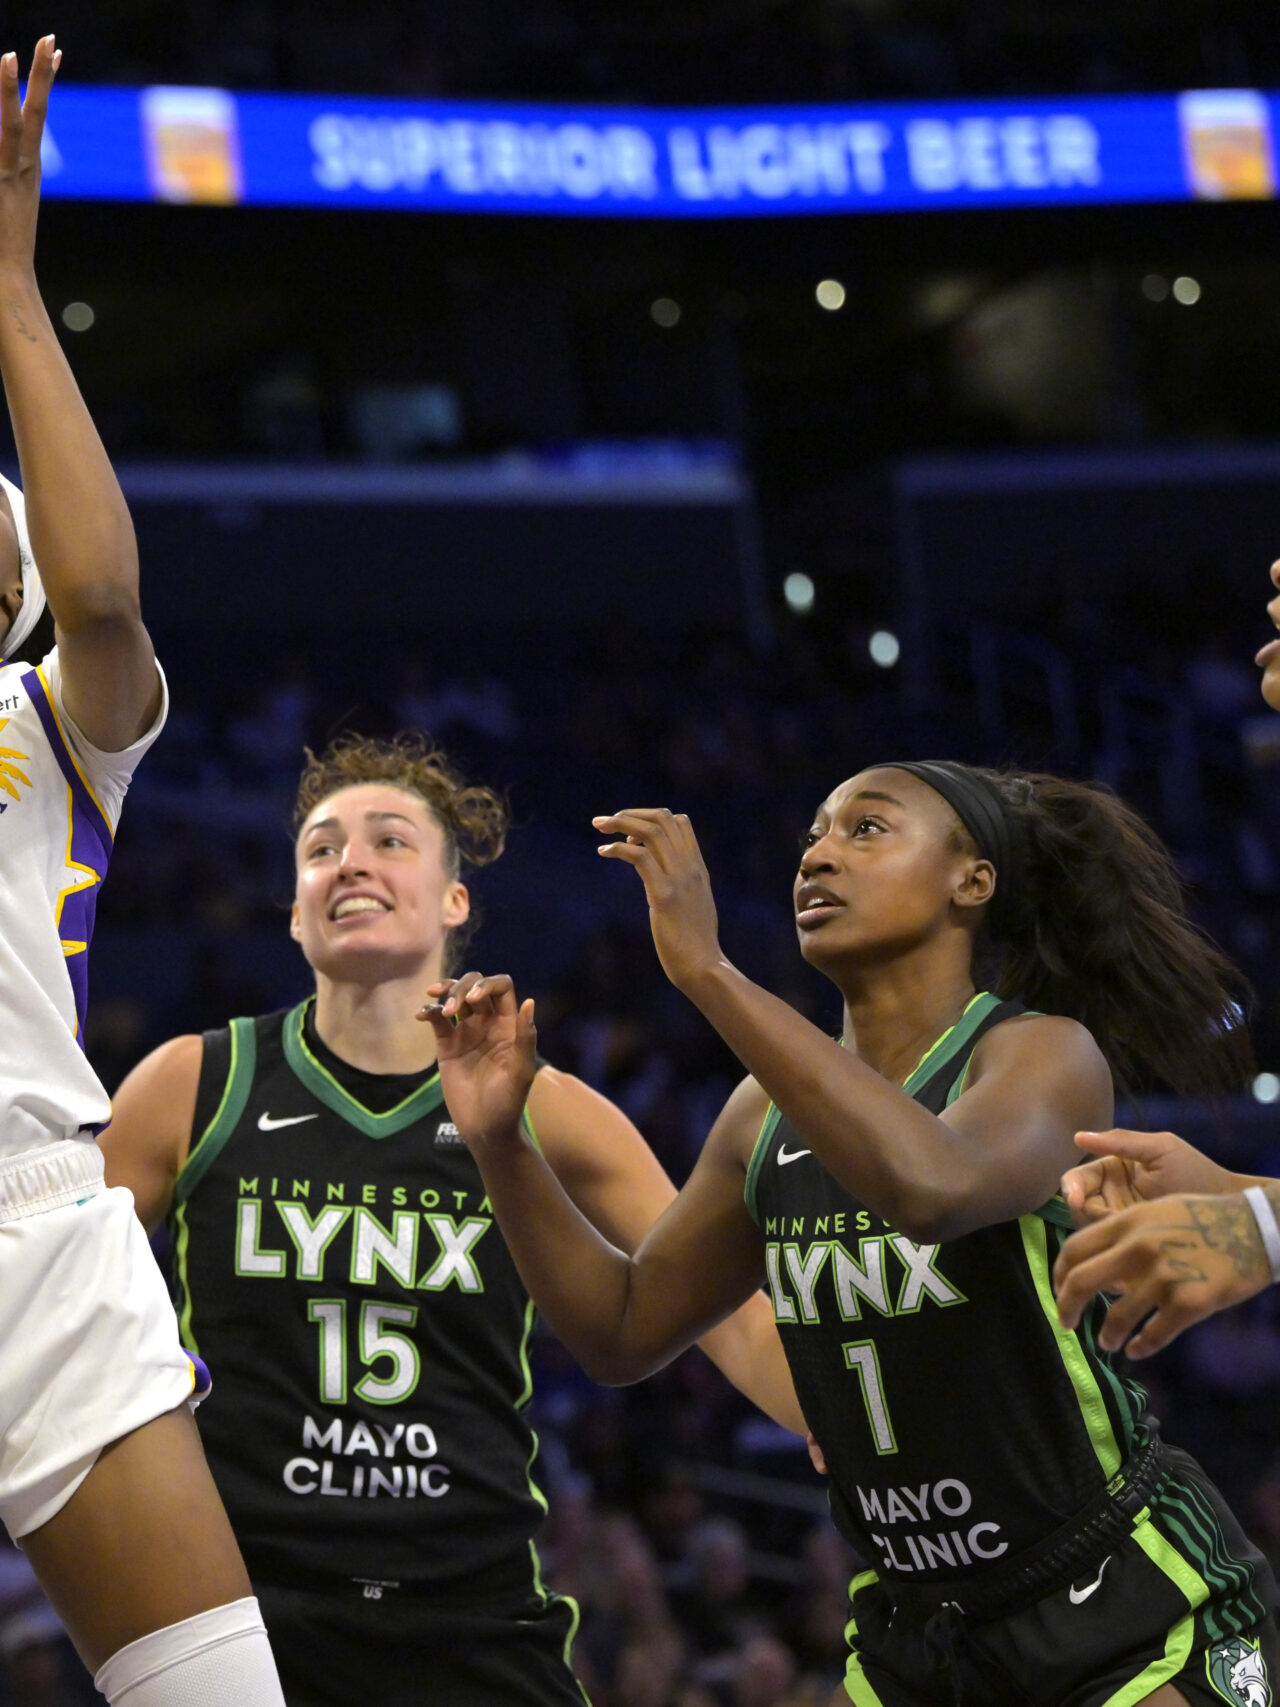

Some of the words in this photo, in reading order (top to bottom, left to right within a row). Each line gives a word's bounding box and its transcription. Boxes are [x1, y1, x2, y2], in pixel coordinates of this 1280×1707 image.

[309, 112, 656, 197] SUPERIOR
[670, 120, 890, 199] LIGHT
[905, 114, 1099, 191] BEER
[239, 1176, 494, 1214] MINNESOTA
[235, 1199, 492, 1293] LYNX
[766, 1210, 891, 1237] MINNES
[766, 1232, 969, 1325] LYNX
[308, 1299, 420, 1405] 15
[842, 1338, 898, 1455] 1
[302, 1415, 438, 1458] MAYO
[283, 1457, 451, 1499] CLINIC
[856, 1478, 972, 1524] MAYO
[363, 1585, 383, 1599] US
